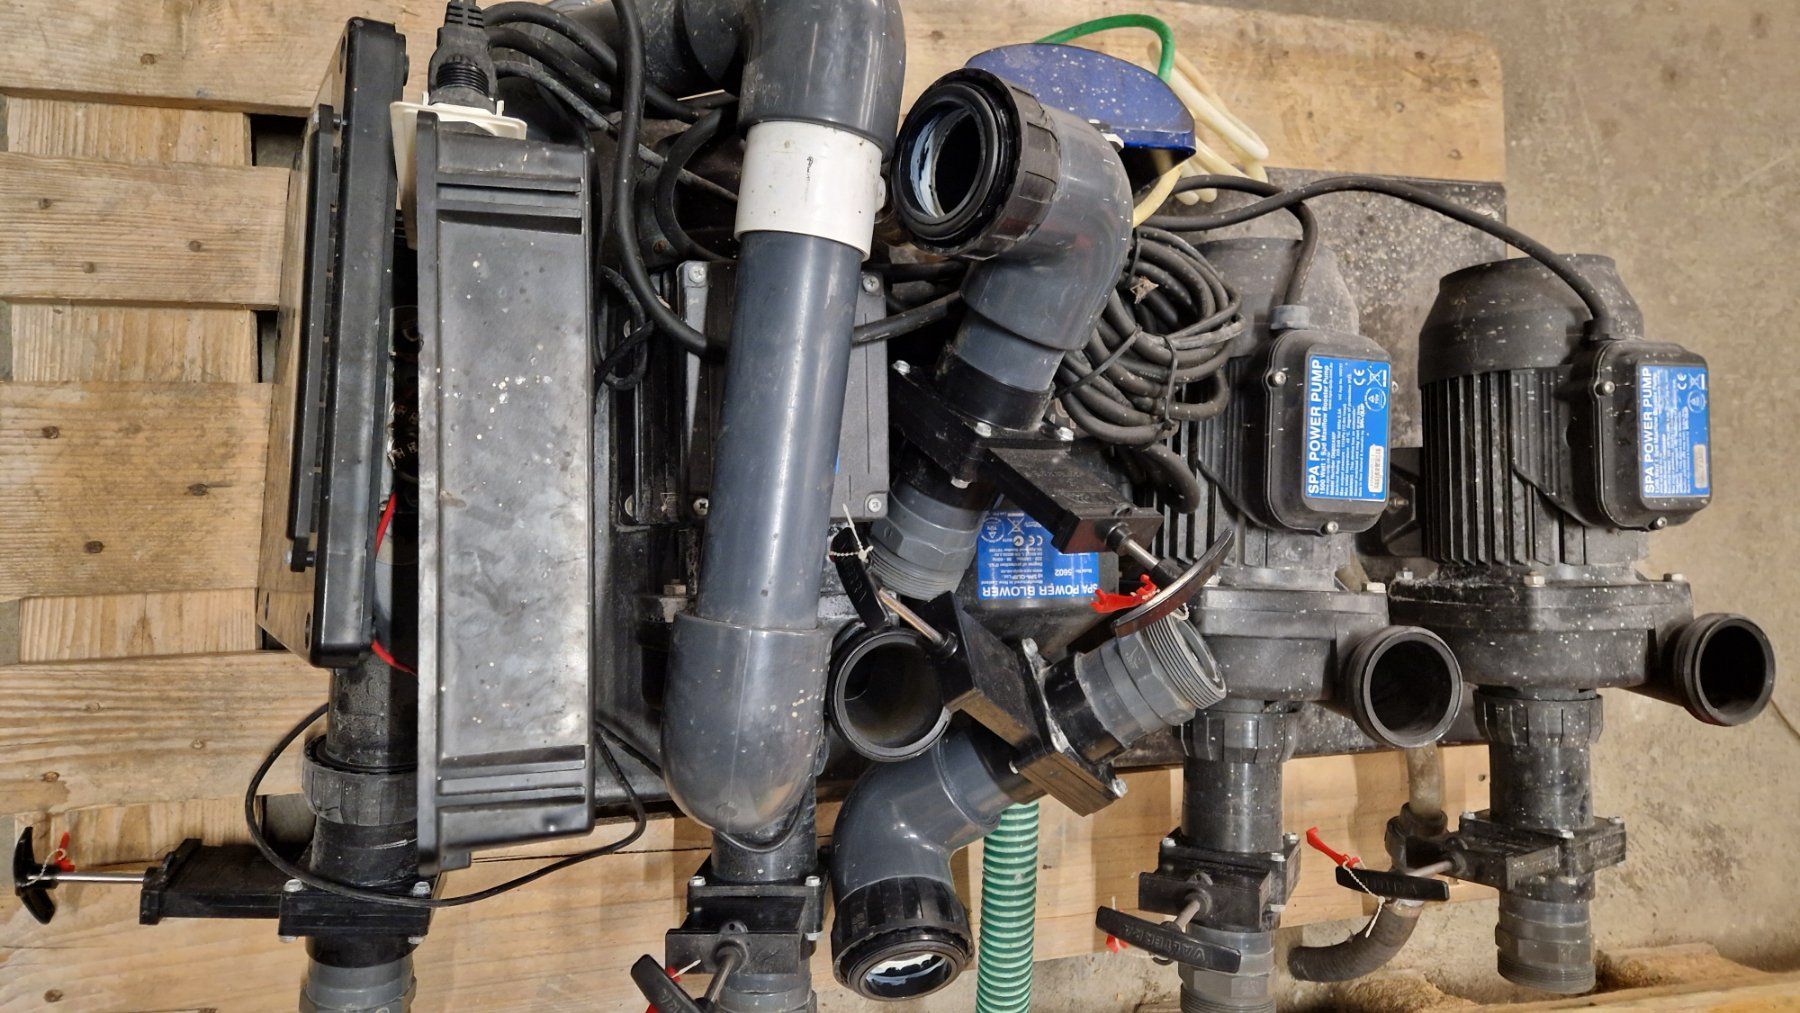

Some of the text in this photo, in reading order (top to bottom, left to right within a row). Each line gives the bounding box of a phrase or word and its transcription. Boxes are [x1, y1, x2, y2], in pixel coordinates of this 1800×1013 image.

[1309, 359, 1322, 494] SPA POWER PUMP
[1642, 368, 1654, 493] SPA POWER PUMP
[1054, 568, 1072, 576] 5602
[982, 586, 1035, 596] BLOWER
[1039, 585, 1079, 595] POWER
